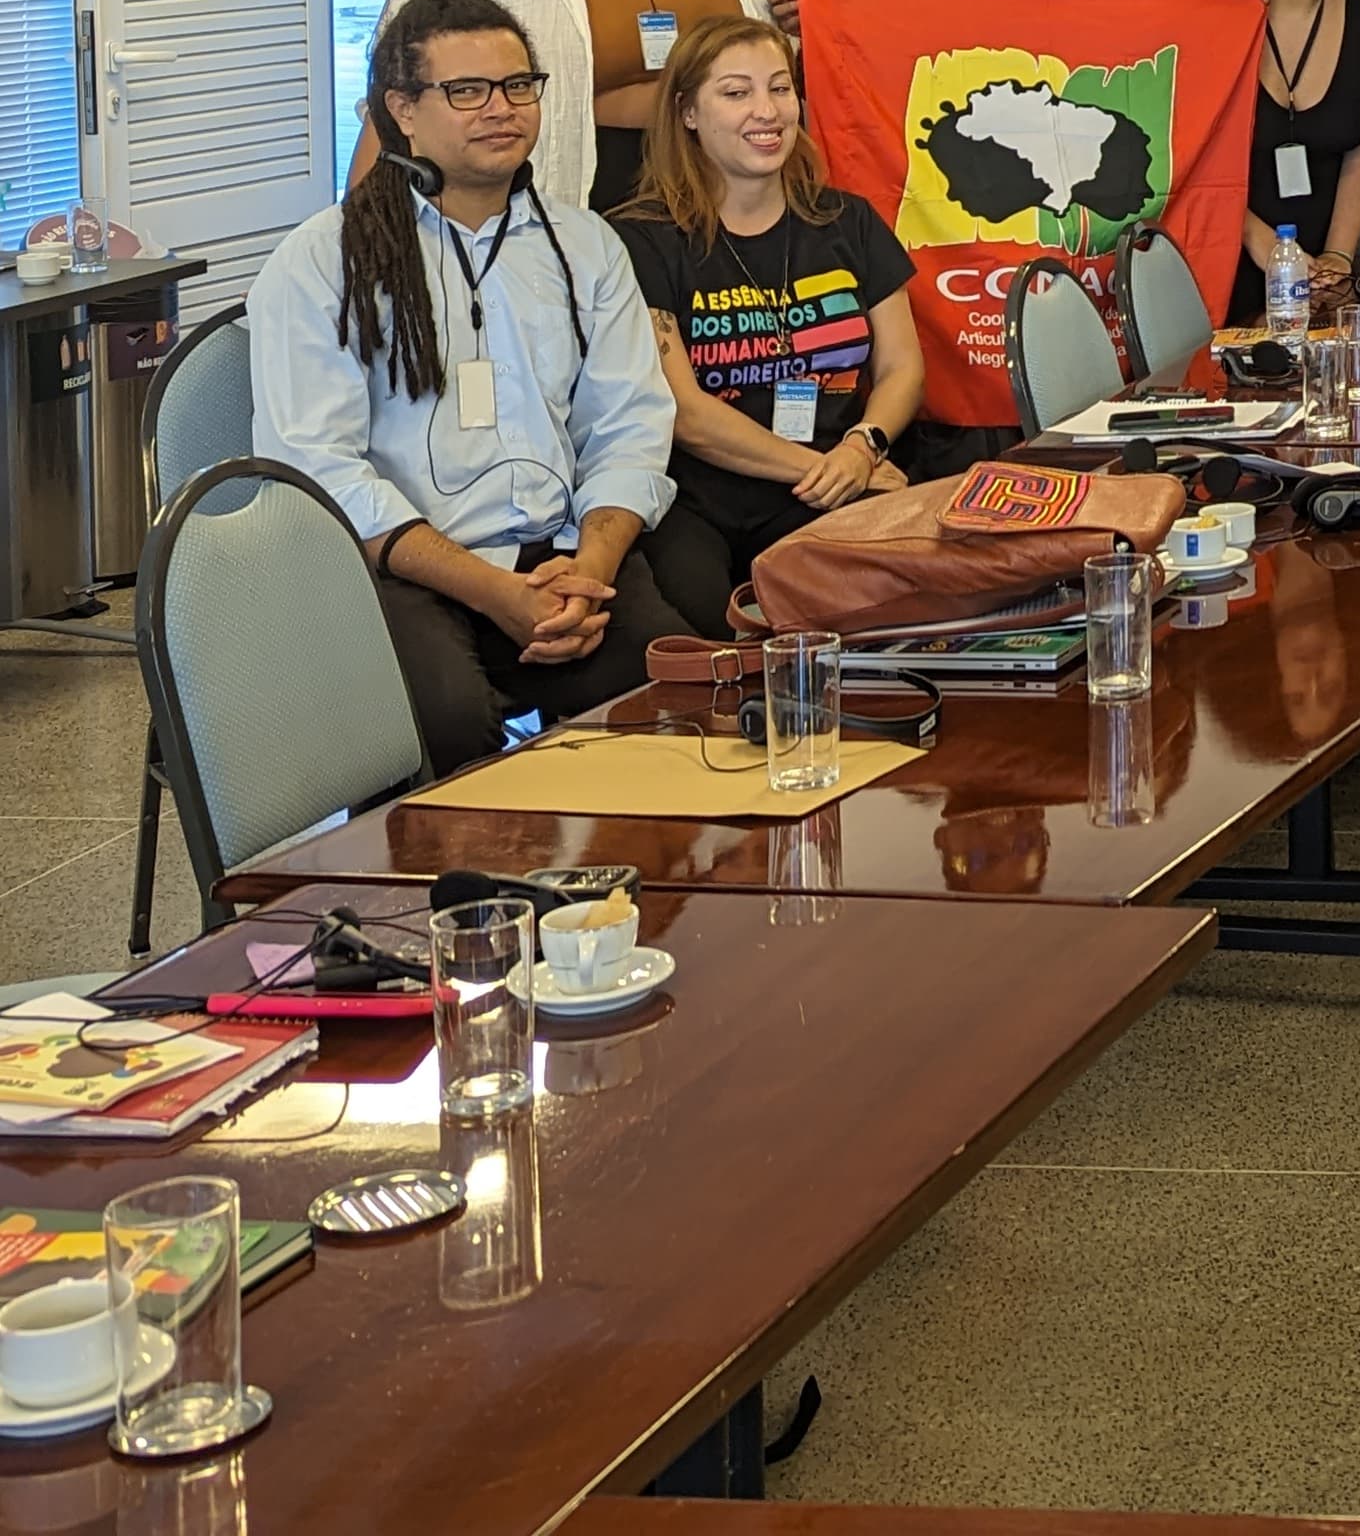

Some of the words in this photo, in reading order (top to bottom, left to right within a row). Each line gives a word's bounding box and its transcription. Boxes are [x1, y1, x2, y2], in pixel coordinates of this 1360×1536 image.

[692, 291, 705, 311] A
[691, 315, 732, 339] DOS
[738, 303, 817, 332] DIREOS
[957, 330, 1007, 346] Articul
[691, 336, 790, 367] HUMANO
[968, 350, 1007, 368] Negr
[706, 371, 724, 388] O
[730, 358, 806, 386] DIREITO
